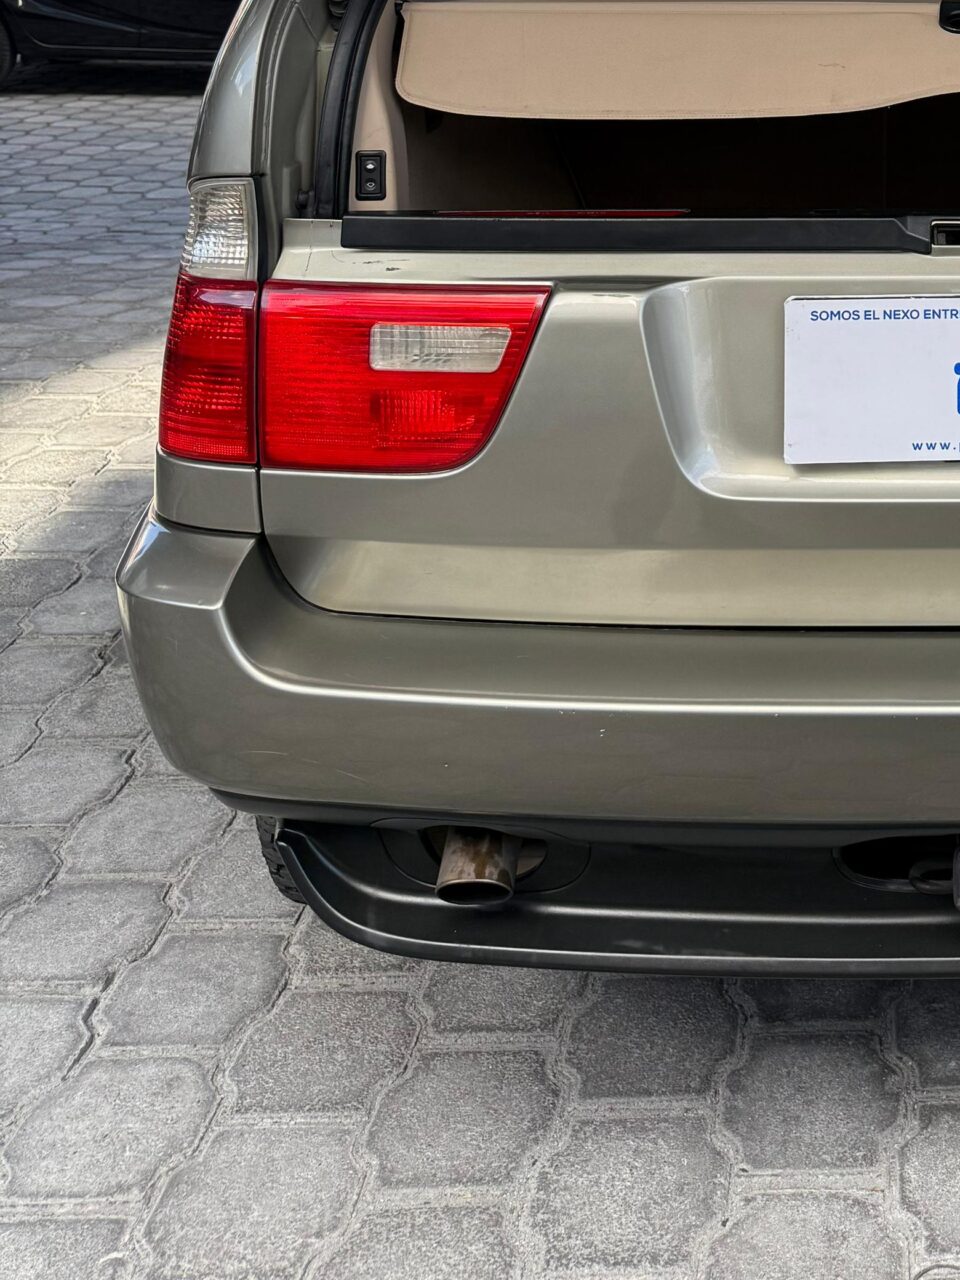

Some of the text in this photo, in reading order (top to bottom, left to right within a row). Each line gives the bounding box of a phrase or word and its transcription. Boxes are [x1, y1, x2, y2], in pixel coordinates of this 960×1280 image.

[810, 310, 861, 321] SOMOS
[864, 310, 880, 320] EL
[882, 309, 920, 320] NEXO
